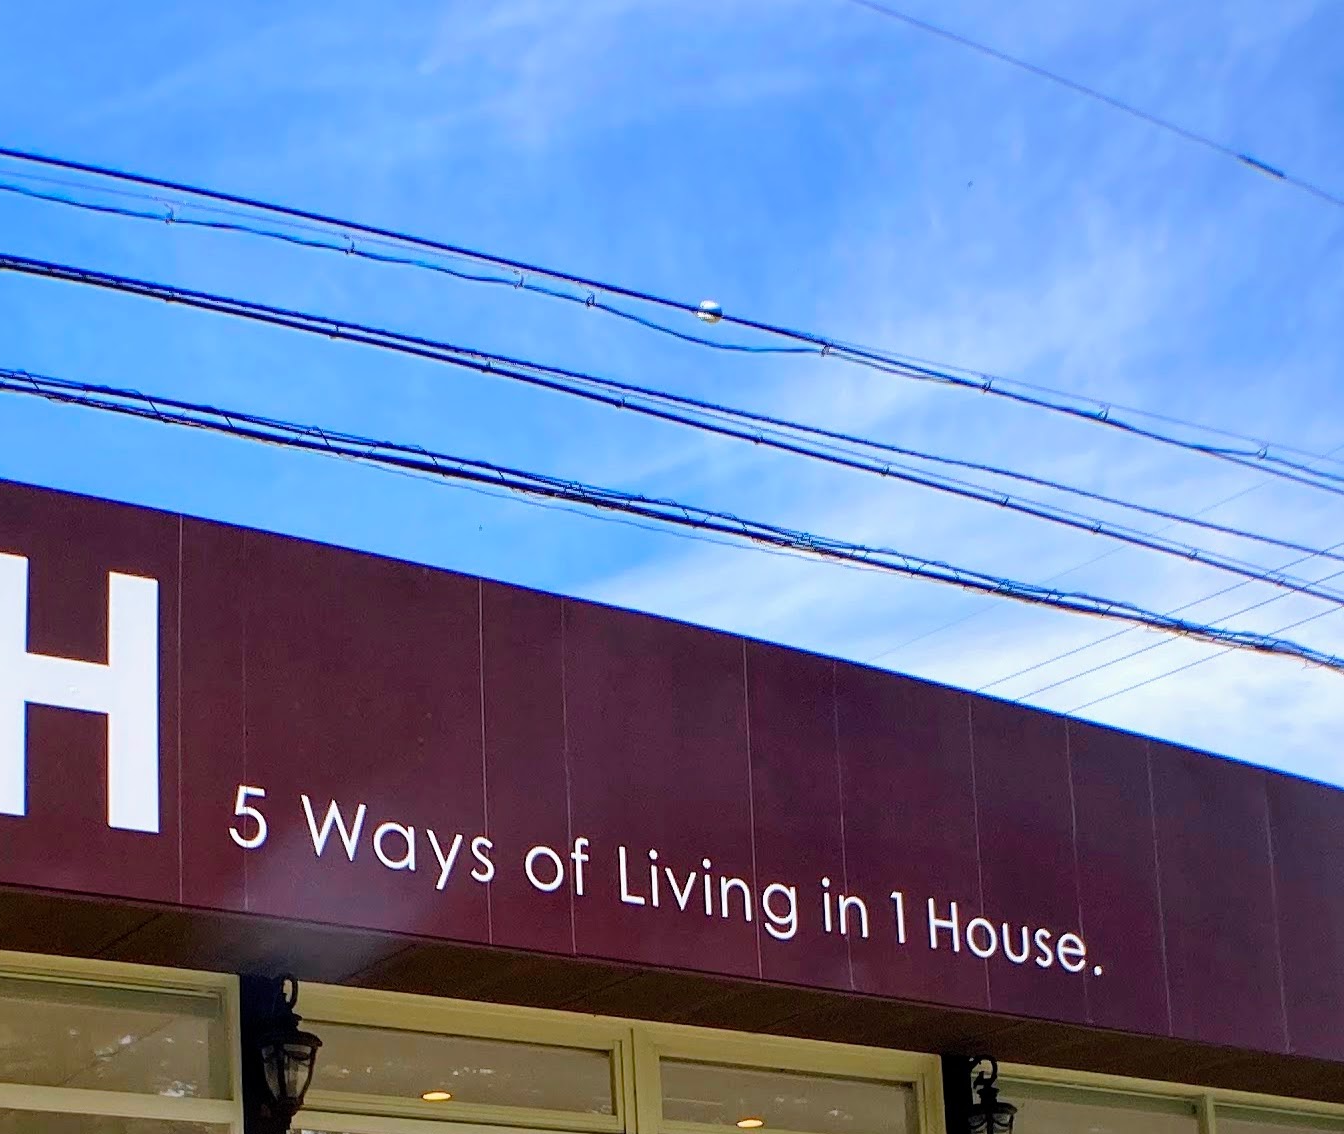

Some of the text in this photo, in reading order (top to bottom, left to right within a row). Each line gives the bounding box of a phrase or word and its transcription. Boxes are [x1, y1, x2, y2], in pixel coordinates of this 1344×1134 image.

[228, 785, 1104, 977] 5 Ways of Living in 1 House.
